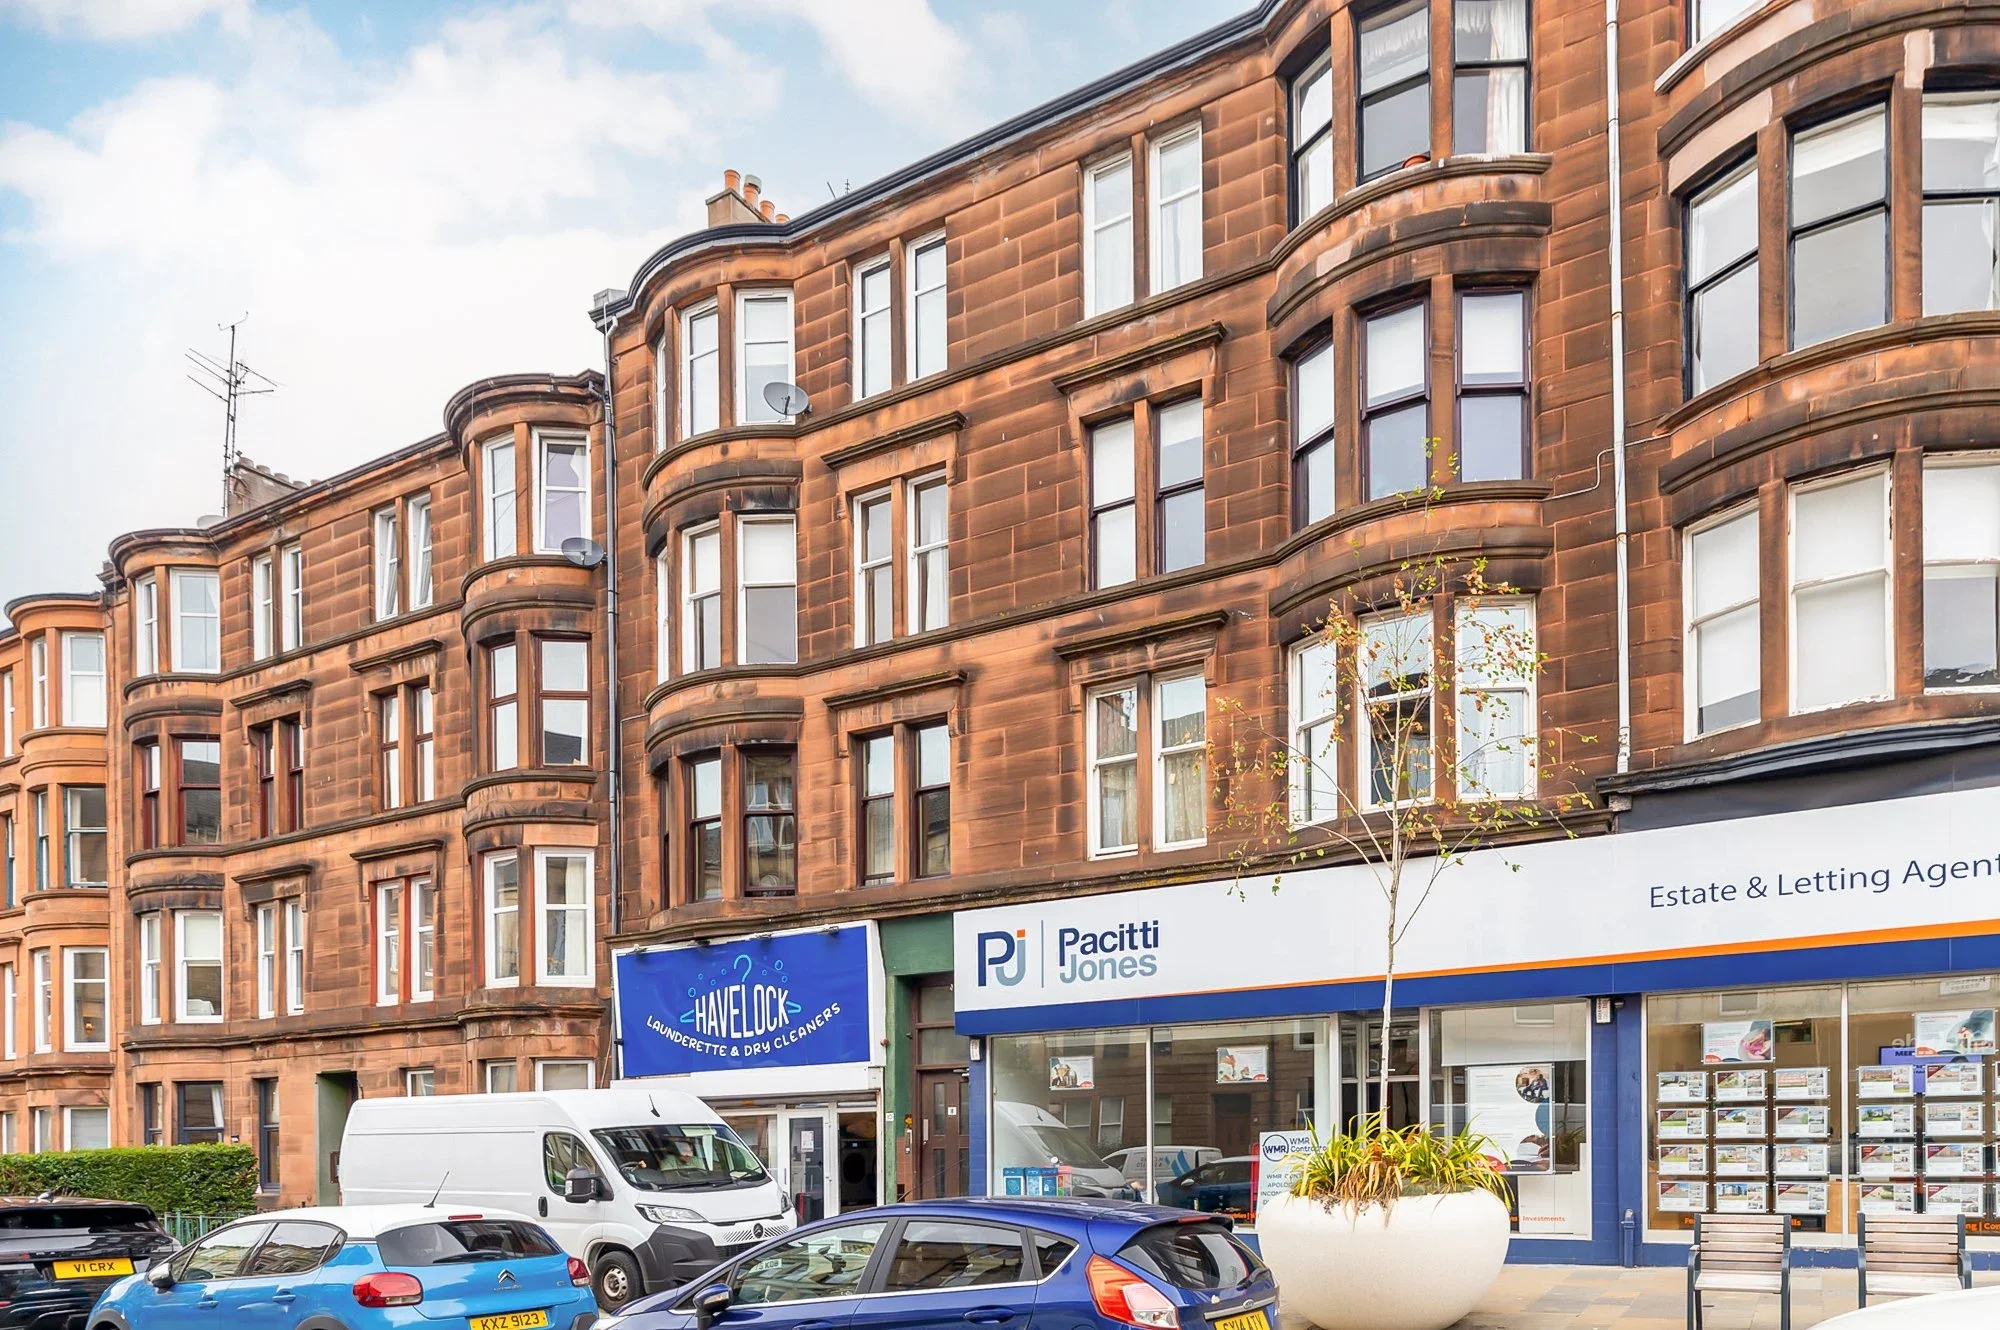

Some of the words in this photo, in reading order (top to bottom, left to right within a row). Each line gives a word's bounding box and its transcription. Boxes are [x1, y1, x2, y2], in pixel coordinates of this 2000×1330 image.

[1650, 882, 1738, 908] Estate
[1746, 876, 1768, 899] &
[1778, 867, 1891, 896] Letting
[1059, 920, 1159, 967] Pacitti
[1059, 954, 1158, 984] Jones
[694, 983, 789, 1039] HAVELOCK
[646, 1015, 727, 1057] LAUNDERETTE
[730, 1045, 740, 1057] &
[744, 1041, 771, 1057] DRY
[774, 1002, 841, 1050] CLEANERS
[1265, 1145, 1287, 1154] WMR
[1289, 1137, 1310, 1145] WMR
[89, 1261, 116, 1272] CRX
[481, 1316, 508, 1330] KXZ
[510, 1313, 540, 1327] 9123
